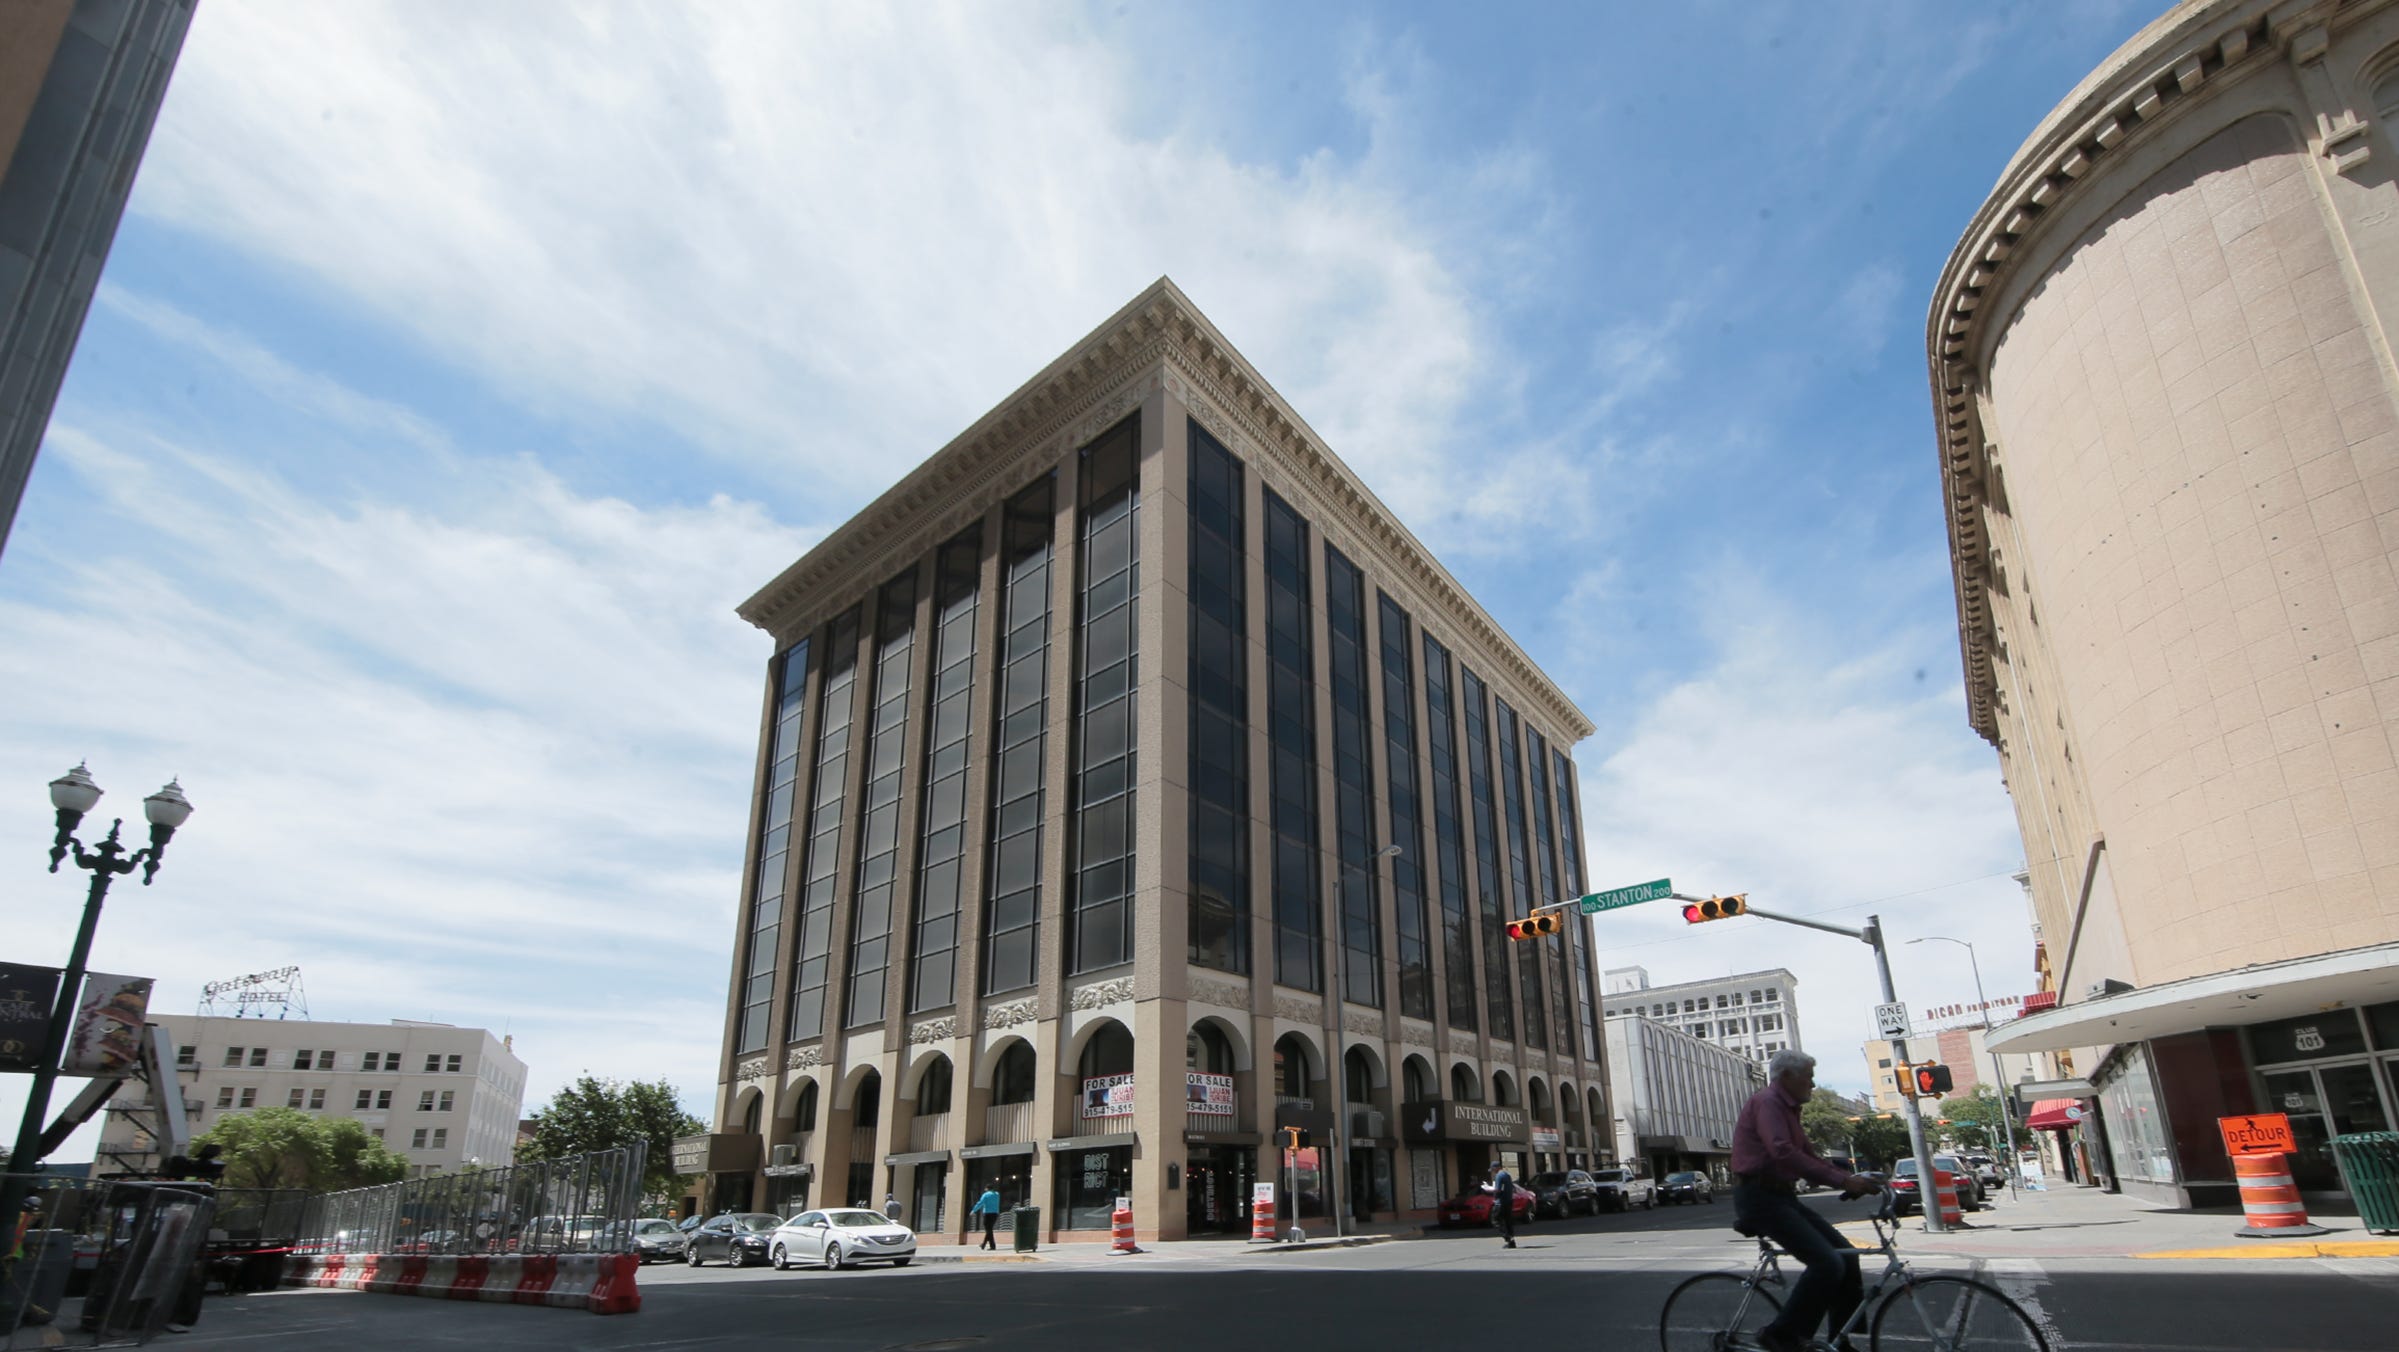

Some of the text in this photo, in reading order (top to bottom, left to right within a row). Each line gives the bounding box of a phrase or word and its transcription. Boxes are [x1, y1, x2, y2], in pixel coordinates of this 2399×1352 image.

[1583, 885, 1670, 912] 100 STANTON 200
[1879, 1005, 1903, 1017] ONE
[1880, 1015, 1904, 1027] WAY
[2300, 1035, 2321, 1049] 101
[1086, 1074, 1134, 1090] FOR SALE
[1187, 1073, 1231, 1088] OR SALE
[1085, 1103, 1133, 1117] 915-479-515
[1186, 1102, 1232, 1113] 15-479-5151
[1455, 1105, 1523, 1124] INTERNATIONAL
[1471, 1122, 1512, 1138] BUILDING
[2228, 1127, 2287, 1143] DETOUR
